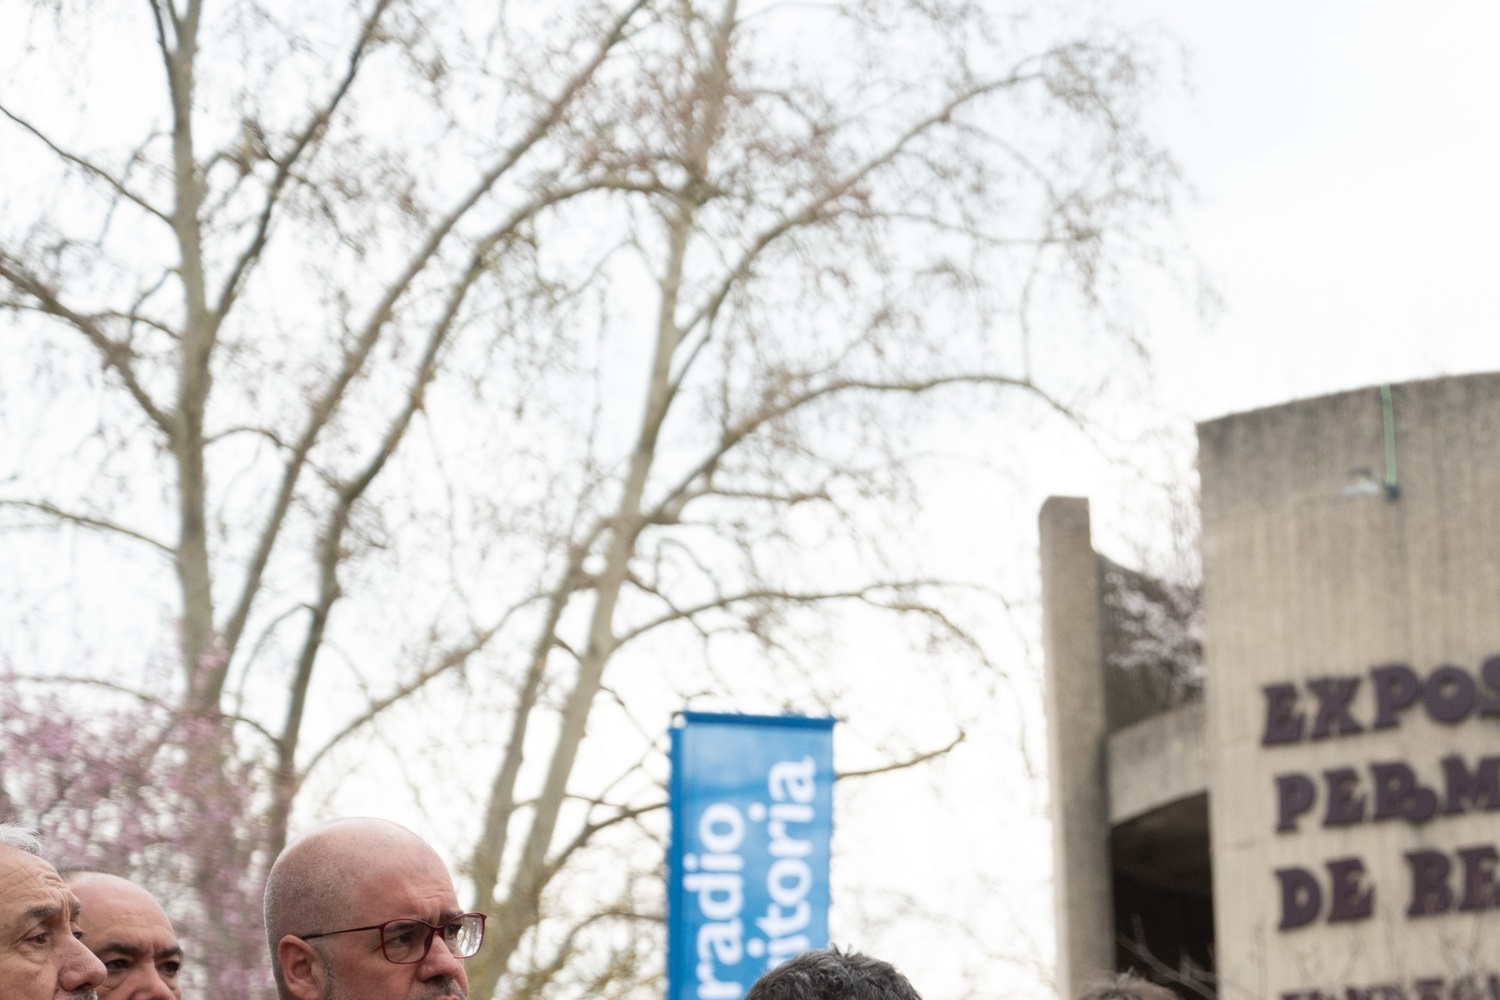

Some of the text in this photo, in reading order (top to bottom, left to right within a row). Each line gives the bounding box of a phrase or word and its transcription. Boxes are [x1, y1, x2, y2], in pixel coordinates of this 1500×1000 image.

[683, 802, 745, 1000] radio
[747, 756, 816, 970] itoria
[1273, 856, 1376, 931] DE
